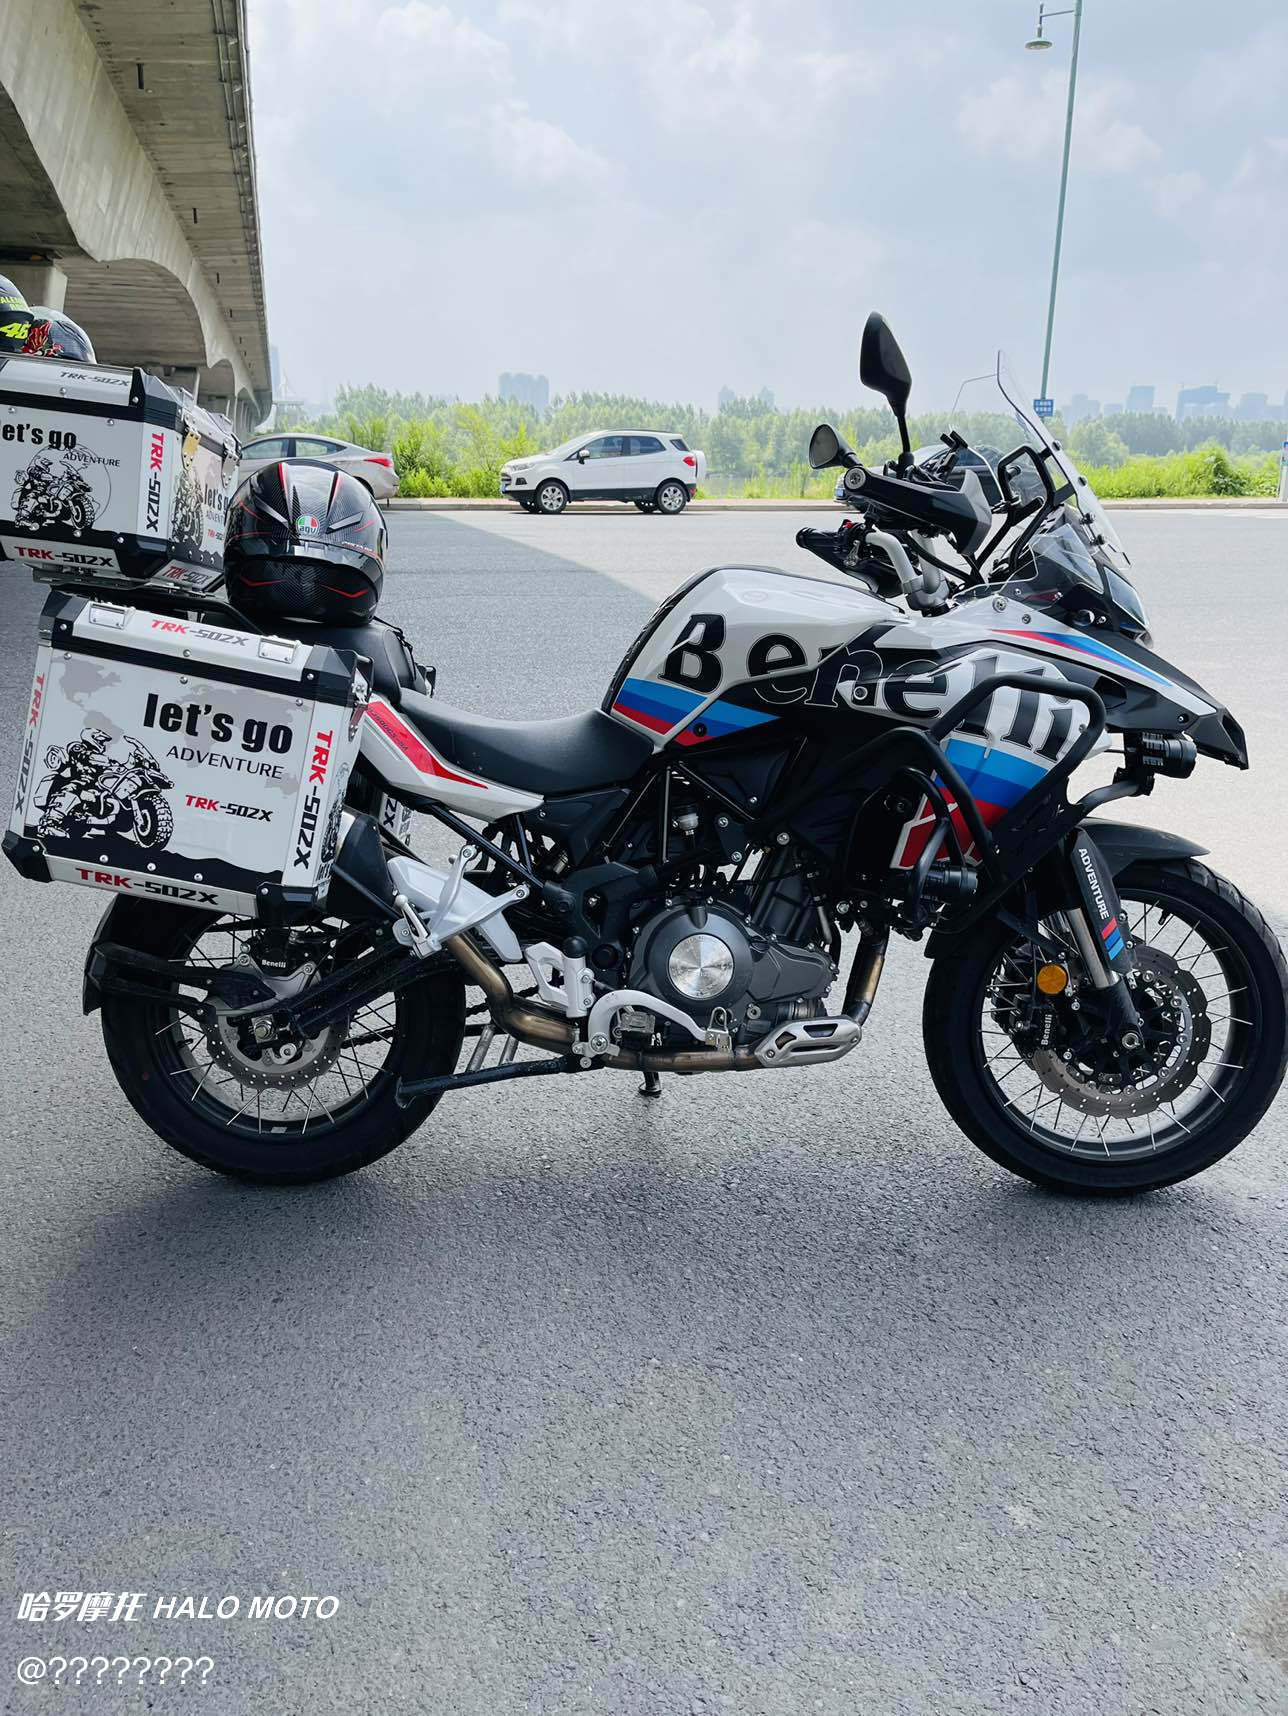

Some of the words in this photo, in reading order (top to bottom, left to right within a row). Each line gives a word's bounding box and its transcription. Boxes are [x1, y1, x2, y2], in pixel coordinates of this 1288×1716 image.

[0, 322, 31, 340] 46
[0, 422, 43, 445] et's
[49, 429, 77, 449] go
[63, 452, 121, 467] ADVENTURE
[146, 432, 165, 532] TRK-502X
[14, 545, 114, 568] TRK-502X
[151, 619, 249, 647] TRK-502X
[656, 613, 1076, 762] Benelli
[143, 692, 234, 743] let's
[241, 718, 293, 754] go
[15, 672, 45, 816] TRK-502X
[166, 745, 285, 780] ADVENTURE
[185, 794, 274, 822] TRK-502X
[293, 730, 333, 870] TRK-502X
[75, 867, 219, 905] TRK-502X
[1078, 847, 1110, 920] ADVENTURE
[1040, 1014, 1053, 1046] Benelli
